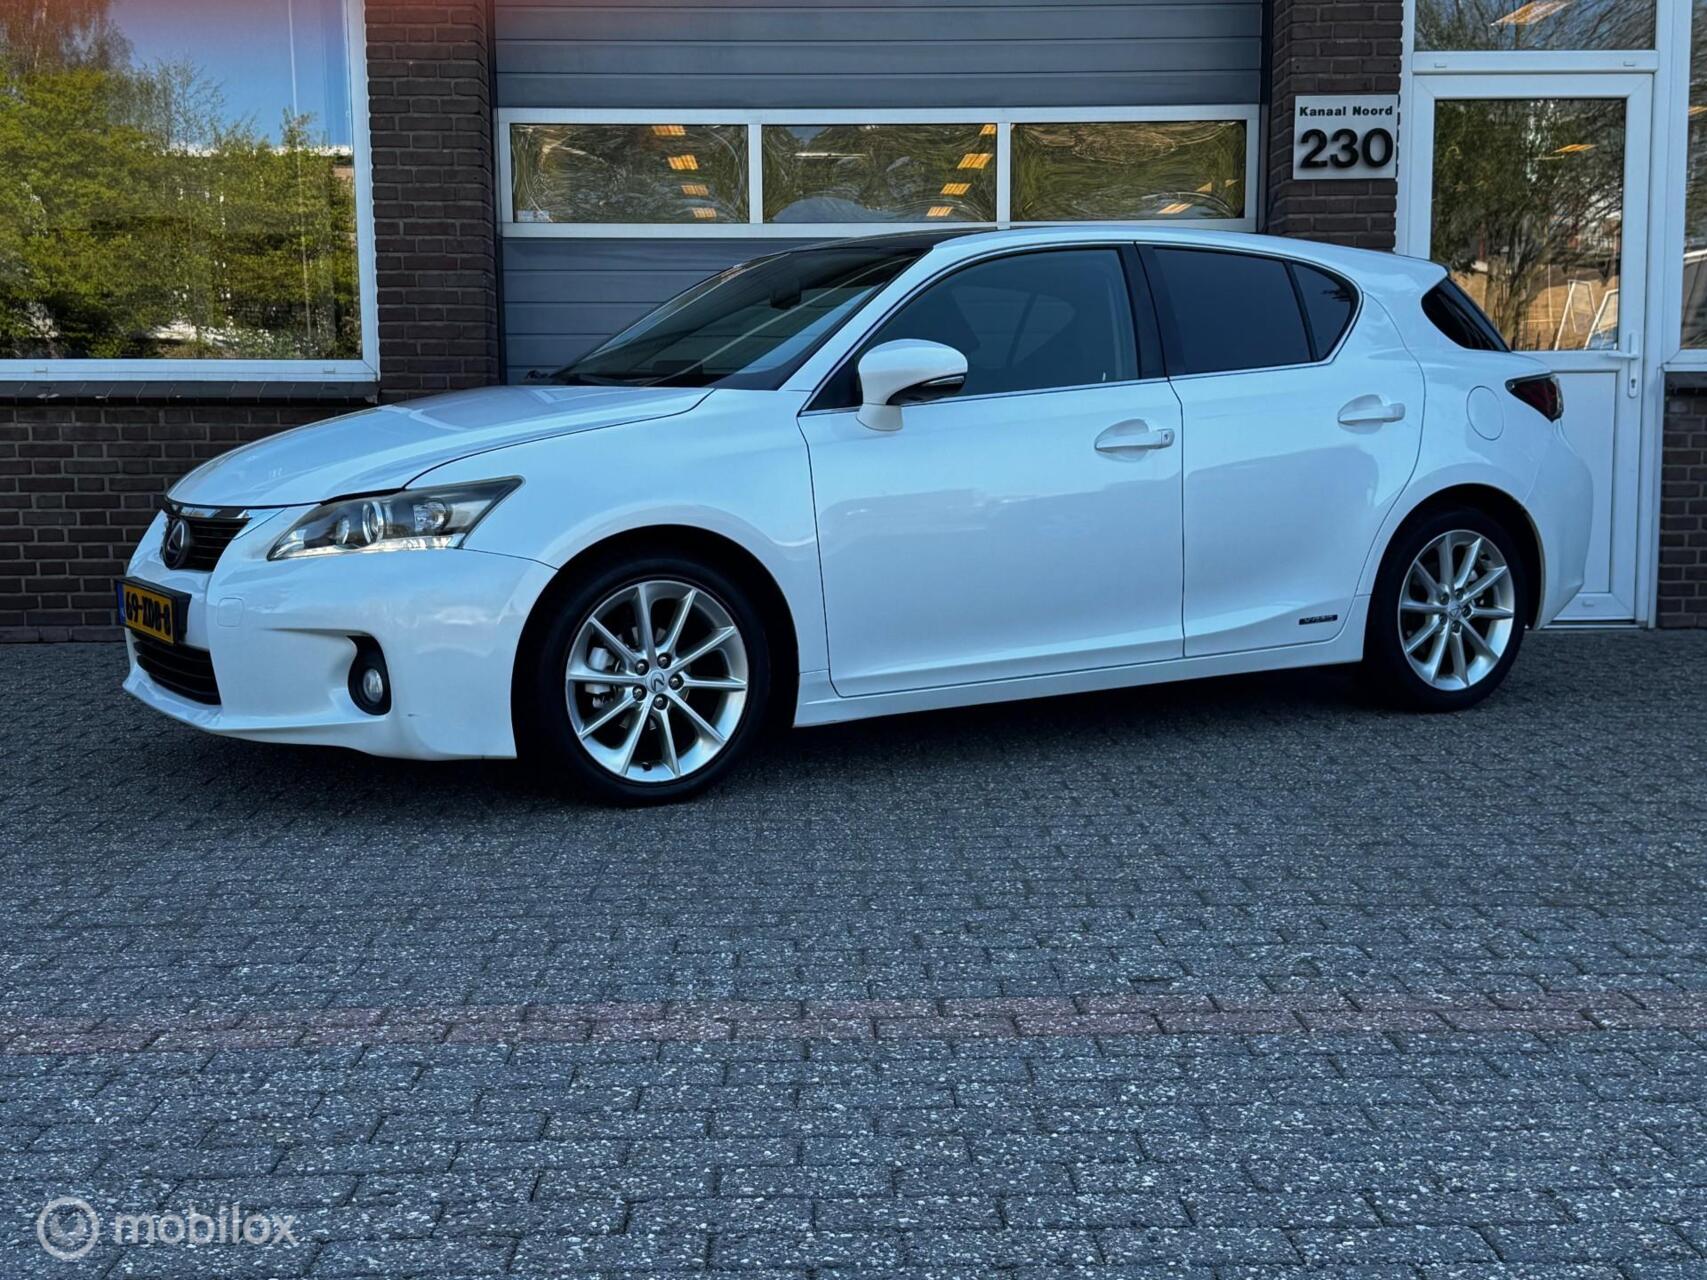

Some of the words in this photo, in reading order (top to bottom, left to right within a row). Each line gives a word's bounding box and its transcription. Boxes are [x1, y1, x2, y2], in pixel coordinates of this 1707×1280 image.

[1299, 106, 1346, 117] Kanaal
[1352, 105, 1393, 116] Noord
[1300, 128, 1393, 169] 230
